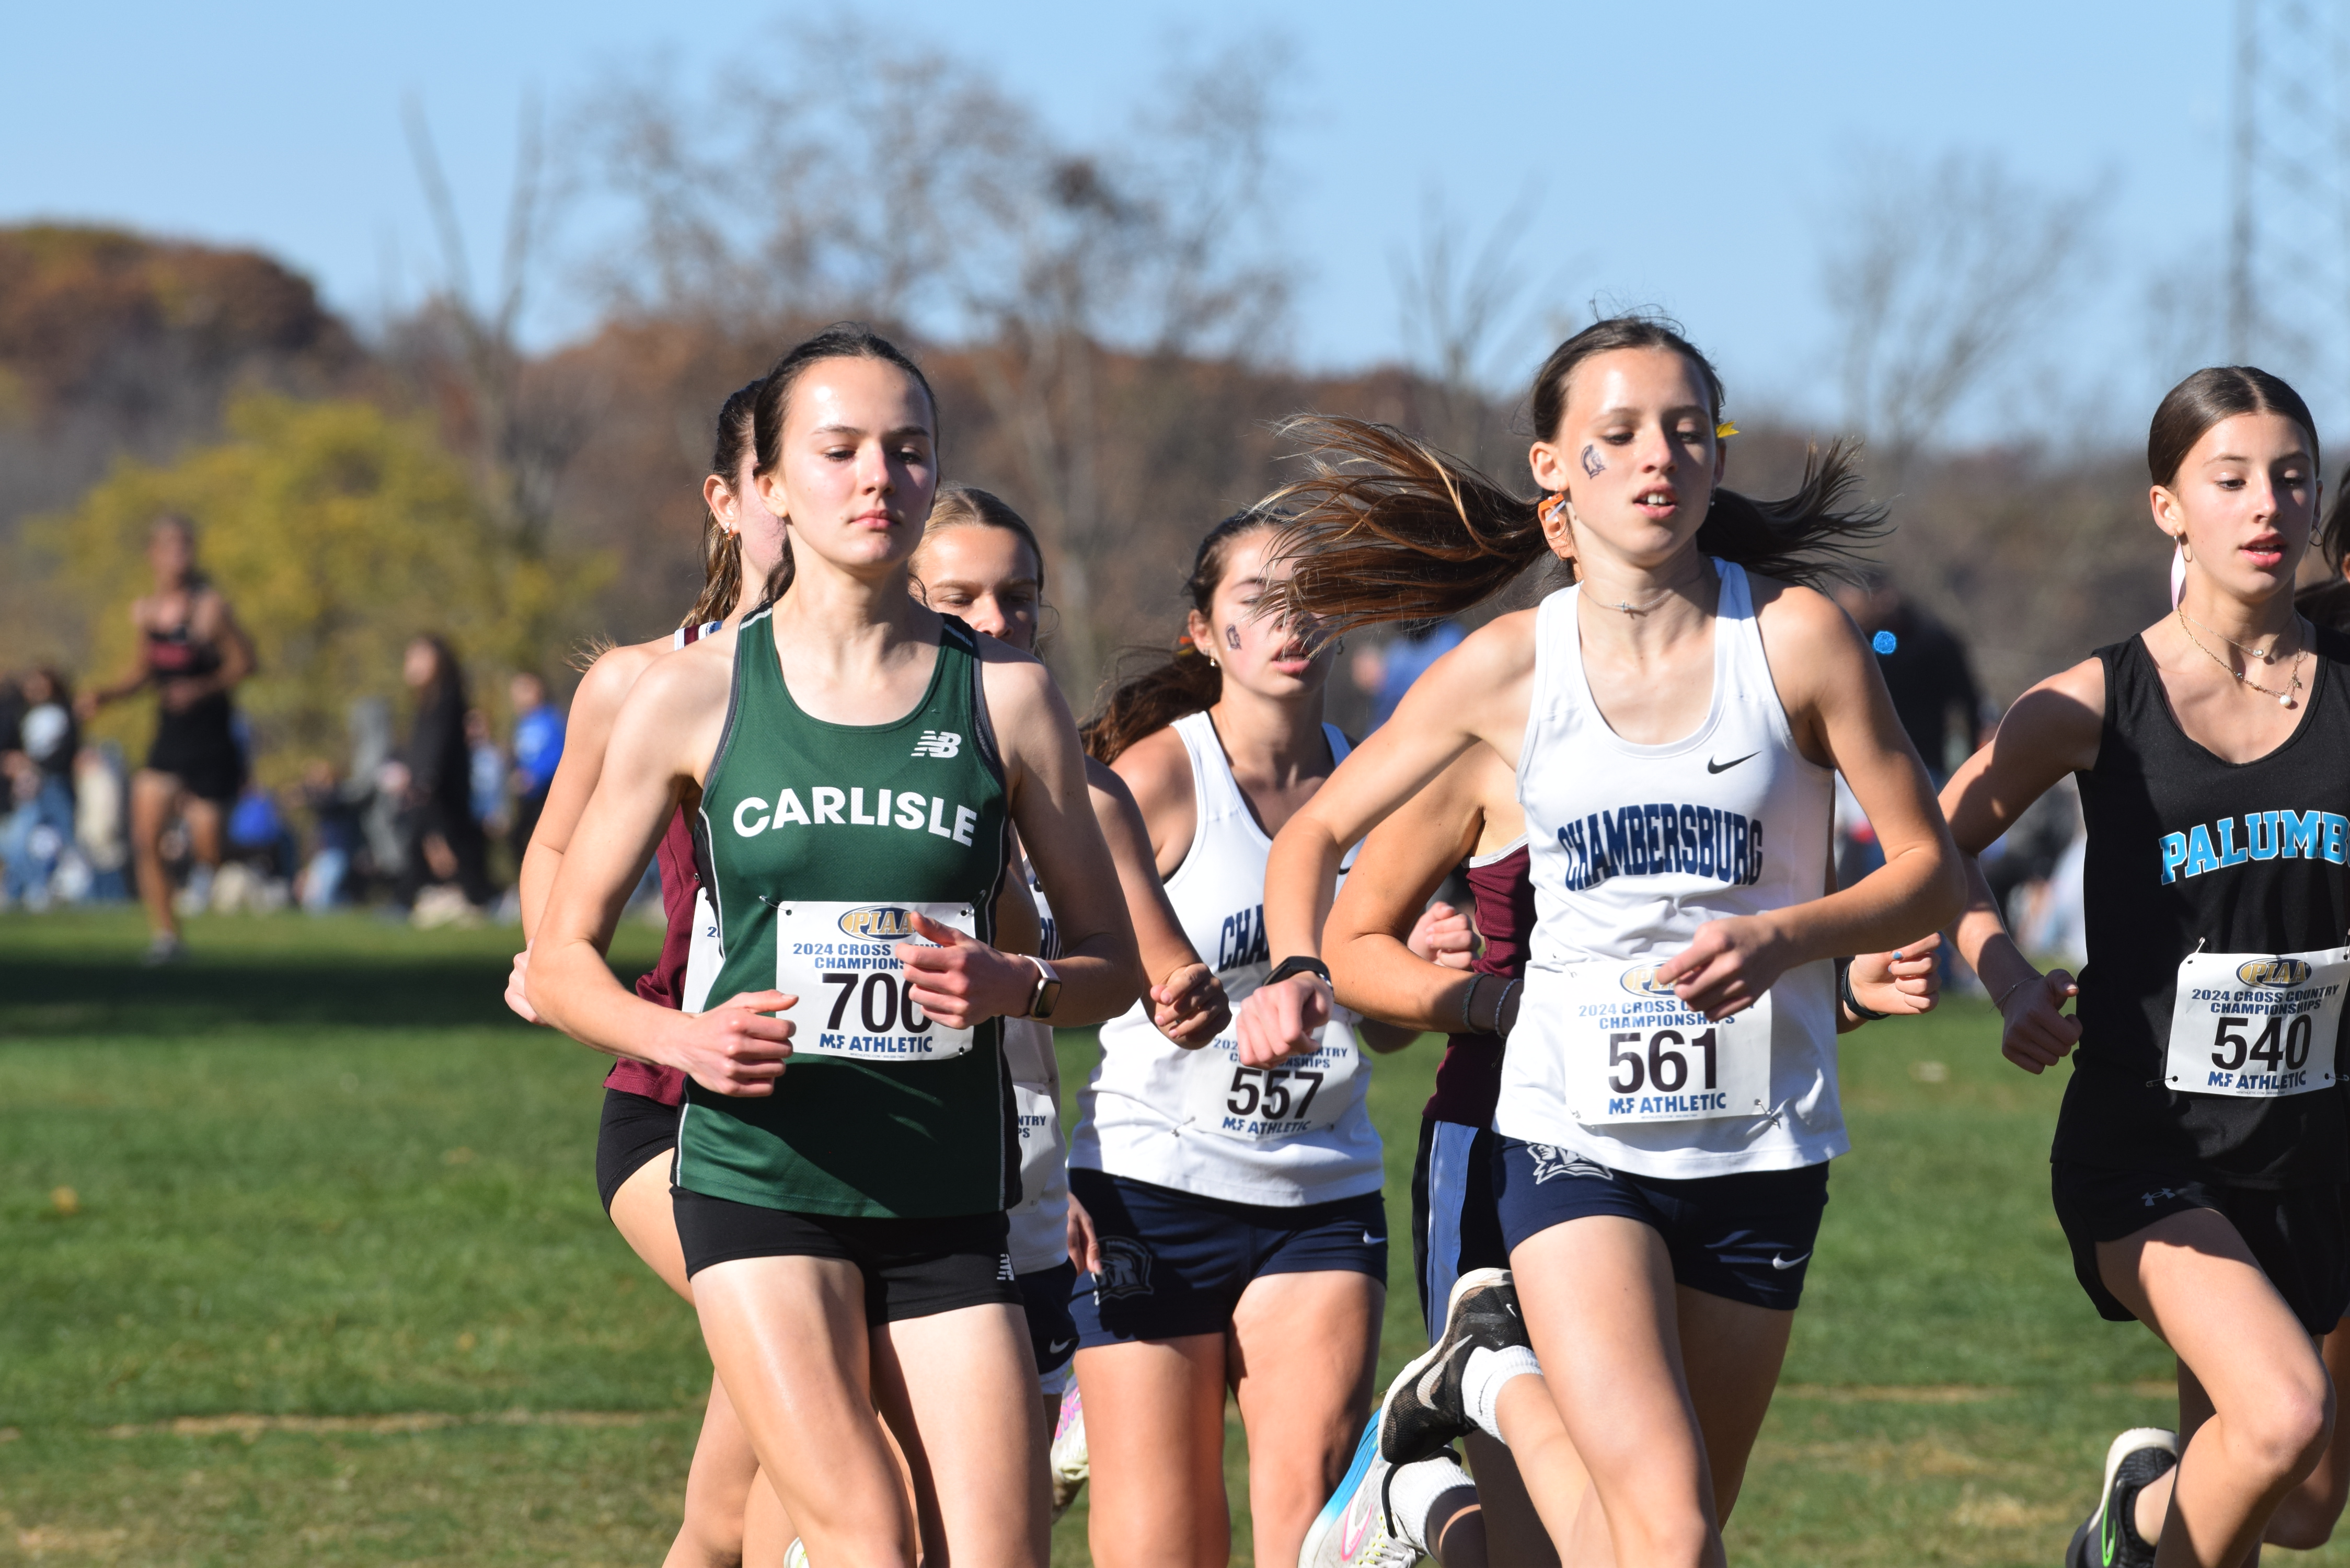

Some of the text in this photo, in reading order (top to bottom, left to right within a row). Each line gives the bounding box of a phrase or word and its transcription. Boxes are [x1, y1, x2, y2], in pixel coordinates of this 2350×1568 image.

[911, 730, 962, 758] NB
[733, 786, 977, 847] CARLISLE
[1558, 803, 1763, 892] CHAMBERSBURG
[2159, 810, 2350, 885] PALUMB
[793, 943, 891, 956] 2024 CROSS
[2247, 961, 2307, 984] PIAA
[822, 973, 932, 1033] 700
[2192, 984, 2340, 1002] 2024 CROSS COUNTRY
[1579, 1004, 1617, 1017] 2024
[1622, 1000, 1675, 1013] CROSS
[2210, 999, 2322, 1016] CHAMPIONSHIPS
[849, 1036, 933, 1053] ATHLETIC
[2211, 1014, 2312, 1071] 540
[1608, 1028, 1717, 1093] 561
[2236, 1070, 2307, 1089] ATHLETIC
[1227, 1066, 1324, 1120] 557
[1640, 1092, 1727, 1113] ATHLETIC
[1248, 1121, 1311, 1135] ATHLETIC
